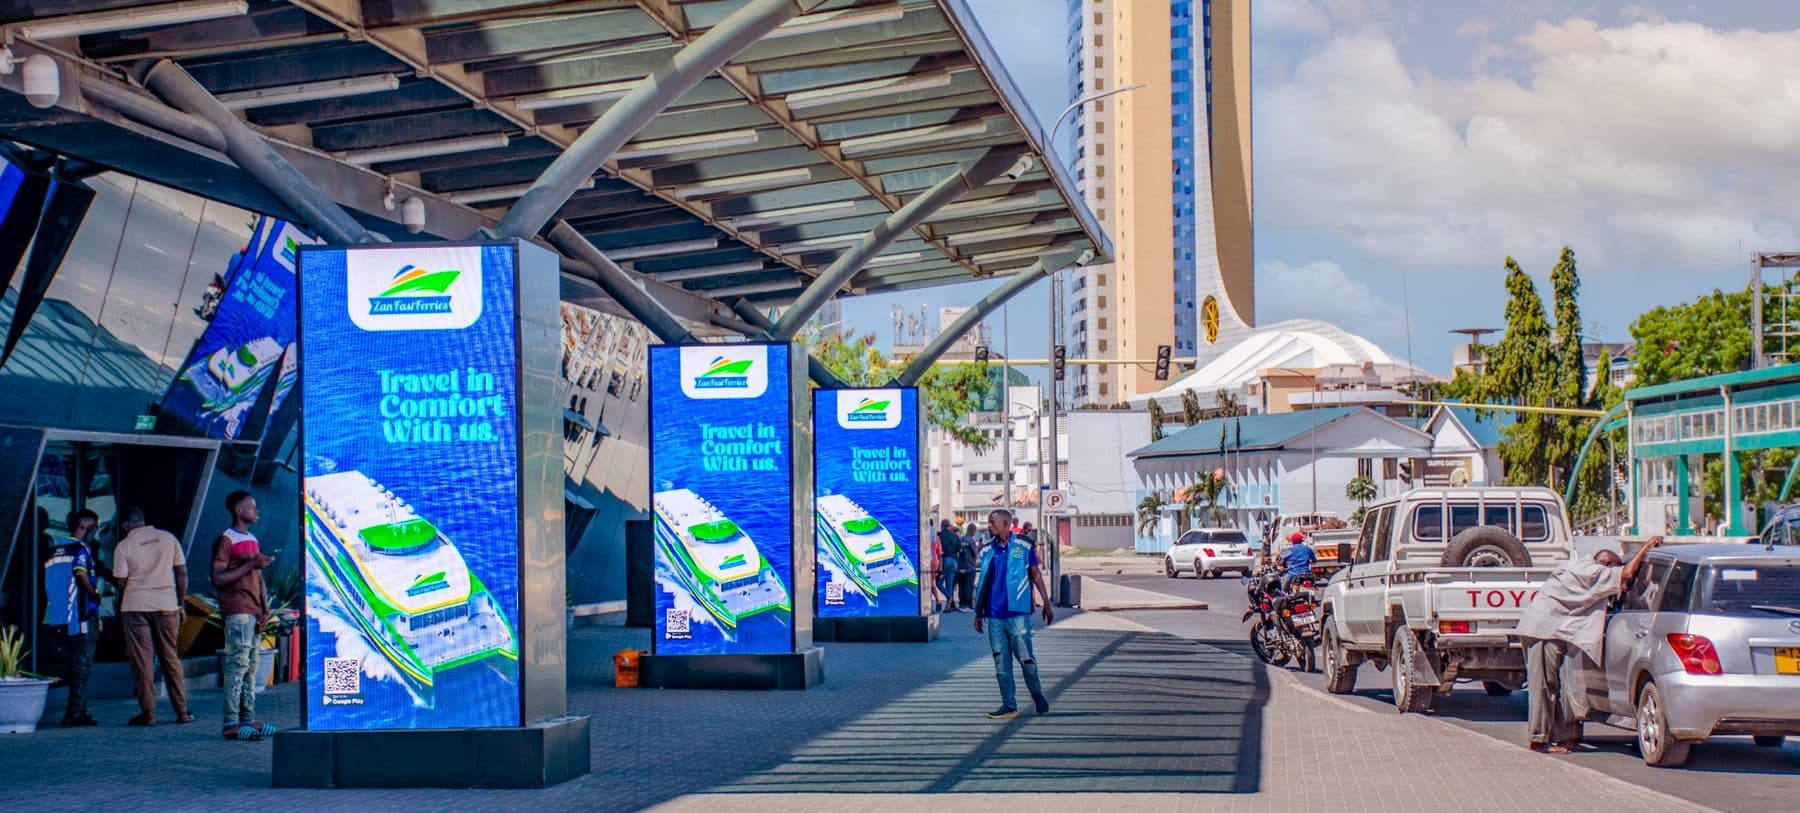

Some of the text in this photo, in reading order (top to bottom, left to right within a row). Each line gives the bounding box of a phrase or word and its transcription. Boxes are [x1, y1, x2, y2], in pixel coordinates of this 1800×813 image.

[373, 299, 448, 312] Zan Fast Ferries
[377, 367, 494, 393] Travel in
[380, 393, 506, 418] Comfort
[383, 418, 499, 443] With us.
[699, 422, 775, 440] Travel in
[701, 439, 783, 456] Comfort
[850, 446, 907, 458] Travel in
[703, 455, 779, 472] With us.
[852, 459, 912, 470] Comfort
[853, 470, 909, 482] With us.
[1051, 495, 1060, 506] P
[1466, 590, 1539, 608] TOY
